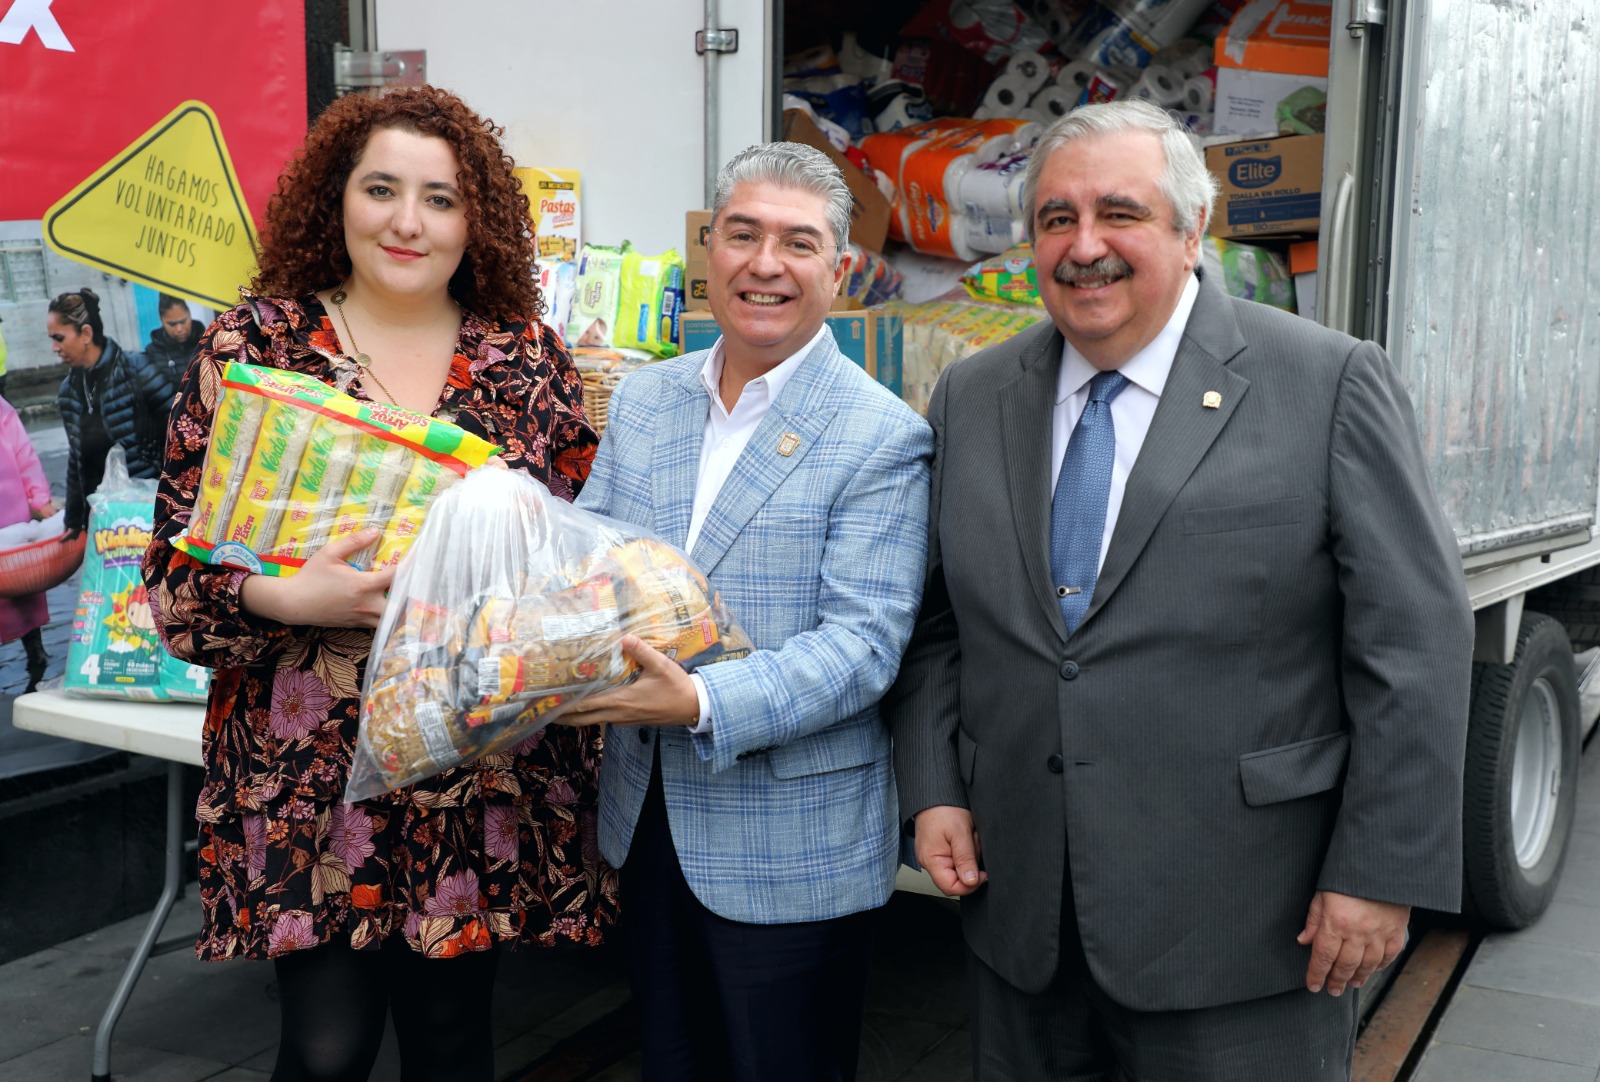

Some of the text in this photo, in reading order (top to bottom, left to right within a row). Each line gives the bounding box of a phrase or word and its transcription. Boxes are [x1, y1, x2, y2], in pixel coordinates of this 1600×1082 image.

[144, 154, 219, 207] HAGAMOS
[1236, 163, 1275, 181] Elite
[540, 199, 576, 214] Pastas
[1230, 191, 1259, 200] TOALLA
[116, 179, 235, 247] VOLUNTARIADO
[135, 225, 196, 267] JUNTOS
[369, 410, 410, 431] Arroz
[217, 422, 237, 458] Verde
[260, 434, 287, 472] Verde
[300, 456, 328, 493] Verde
[348, 468, 376, 505] Verde
[242, 515, 255, 538] Extra
[79, 654, 101, 685] 4
[186, 665, 209, 690] 4
